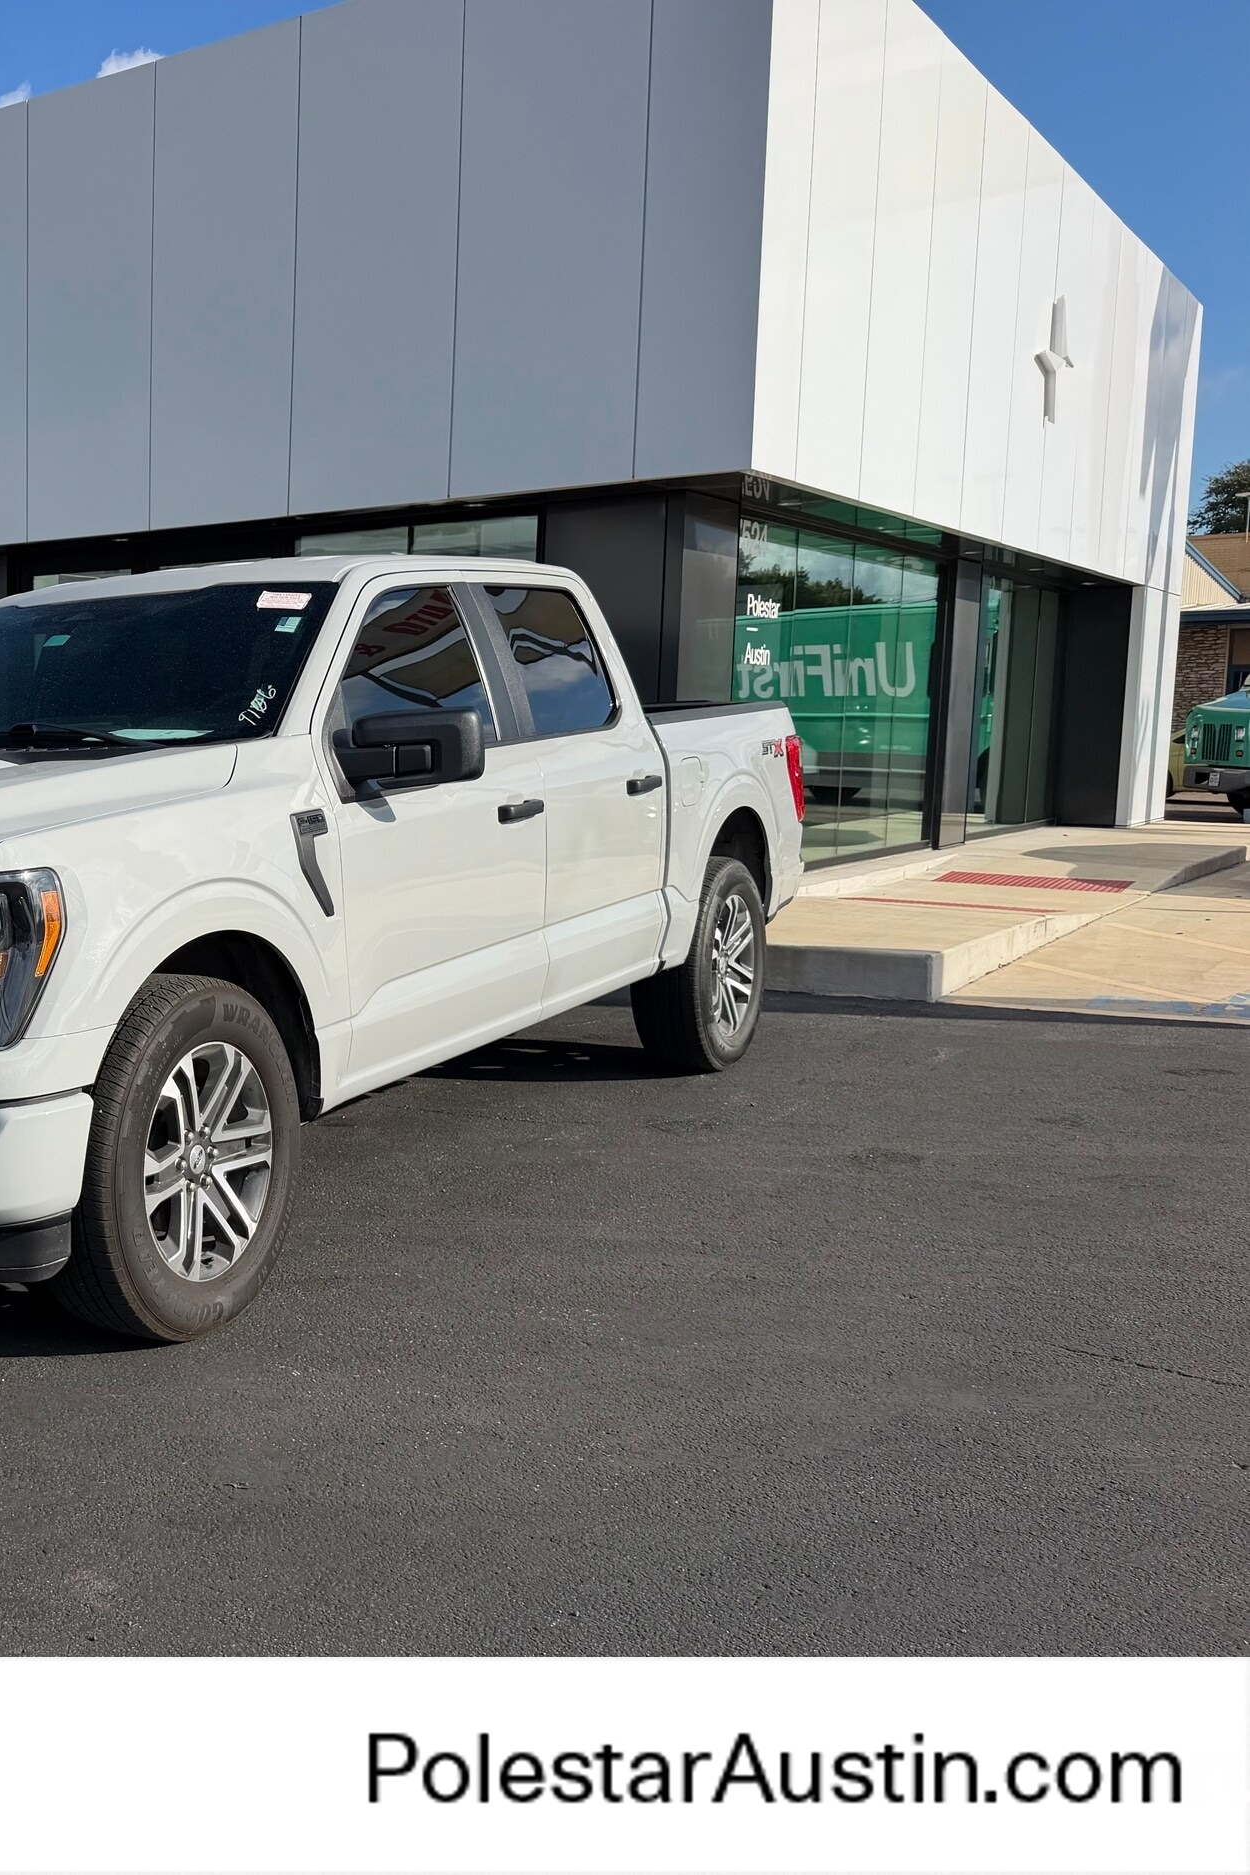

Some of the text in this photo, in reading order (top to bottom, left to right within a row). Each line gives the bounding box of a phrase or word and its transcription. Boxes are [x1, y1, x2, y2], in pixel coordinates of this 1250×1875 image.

[747, 593, 781, 619] Polestar
[744, 642, 771, 666] Austin
[761, 738, 784, 758] STX
